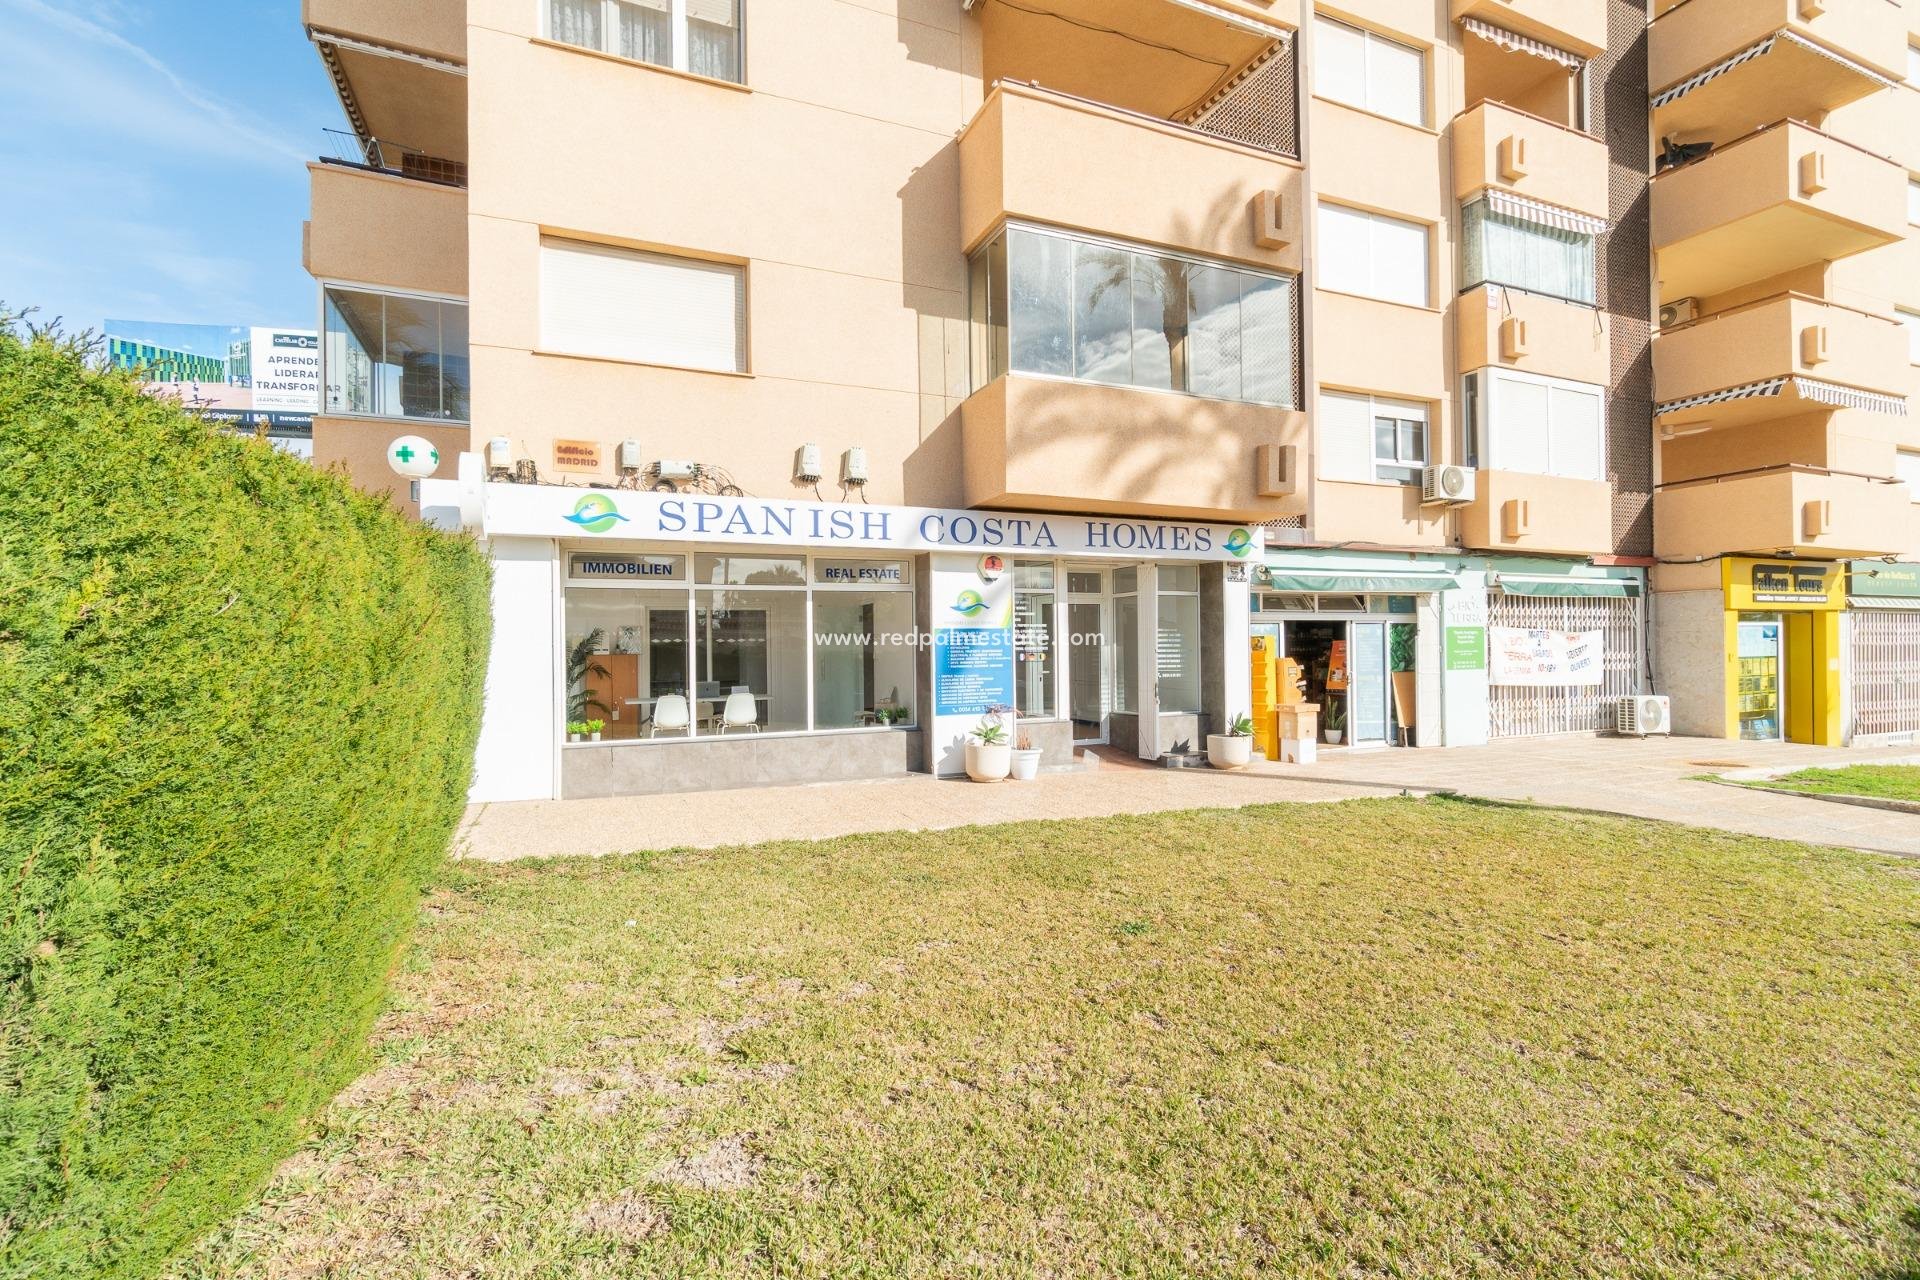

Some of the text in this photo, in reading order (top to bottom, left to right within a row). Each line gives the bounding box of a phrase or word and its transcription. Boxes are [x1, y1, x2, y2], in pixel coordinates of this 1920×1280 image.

[268, 355, 319, 366] APRENDE
[256, 380, 341, 392] TRANSFORAR
[557, 457, 598, 467] MADRID
[659, 500, 1212, 552] SPANISH COSTA HOMES
[582, 561, 673, 575] IMMOBILIEN
[825, 567, 901, 580] REAL ESTATE
